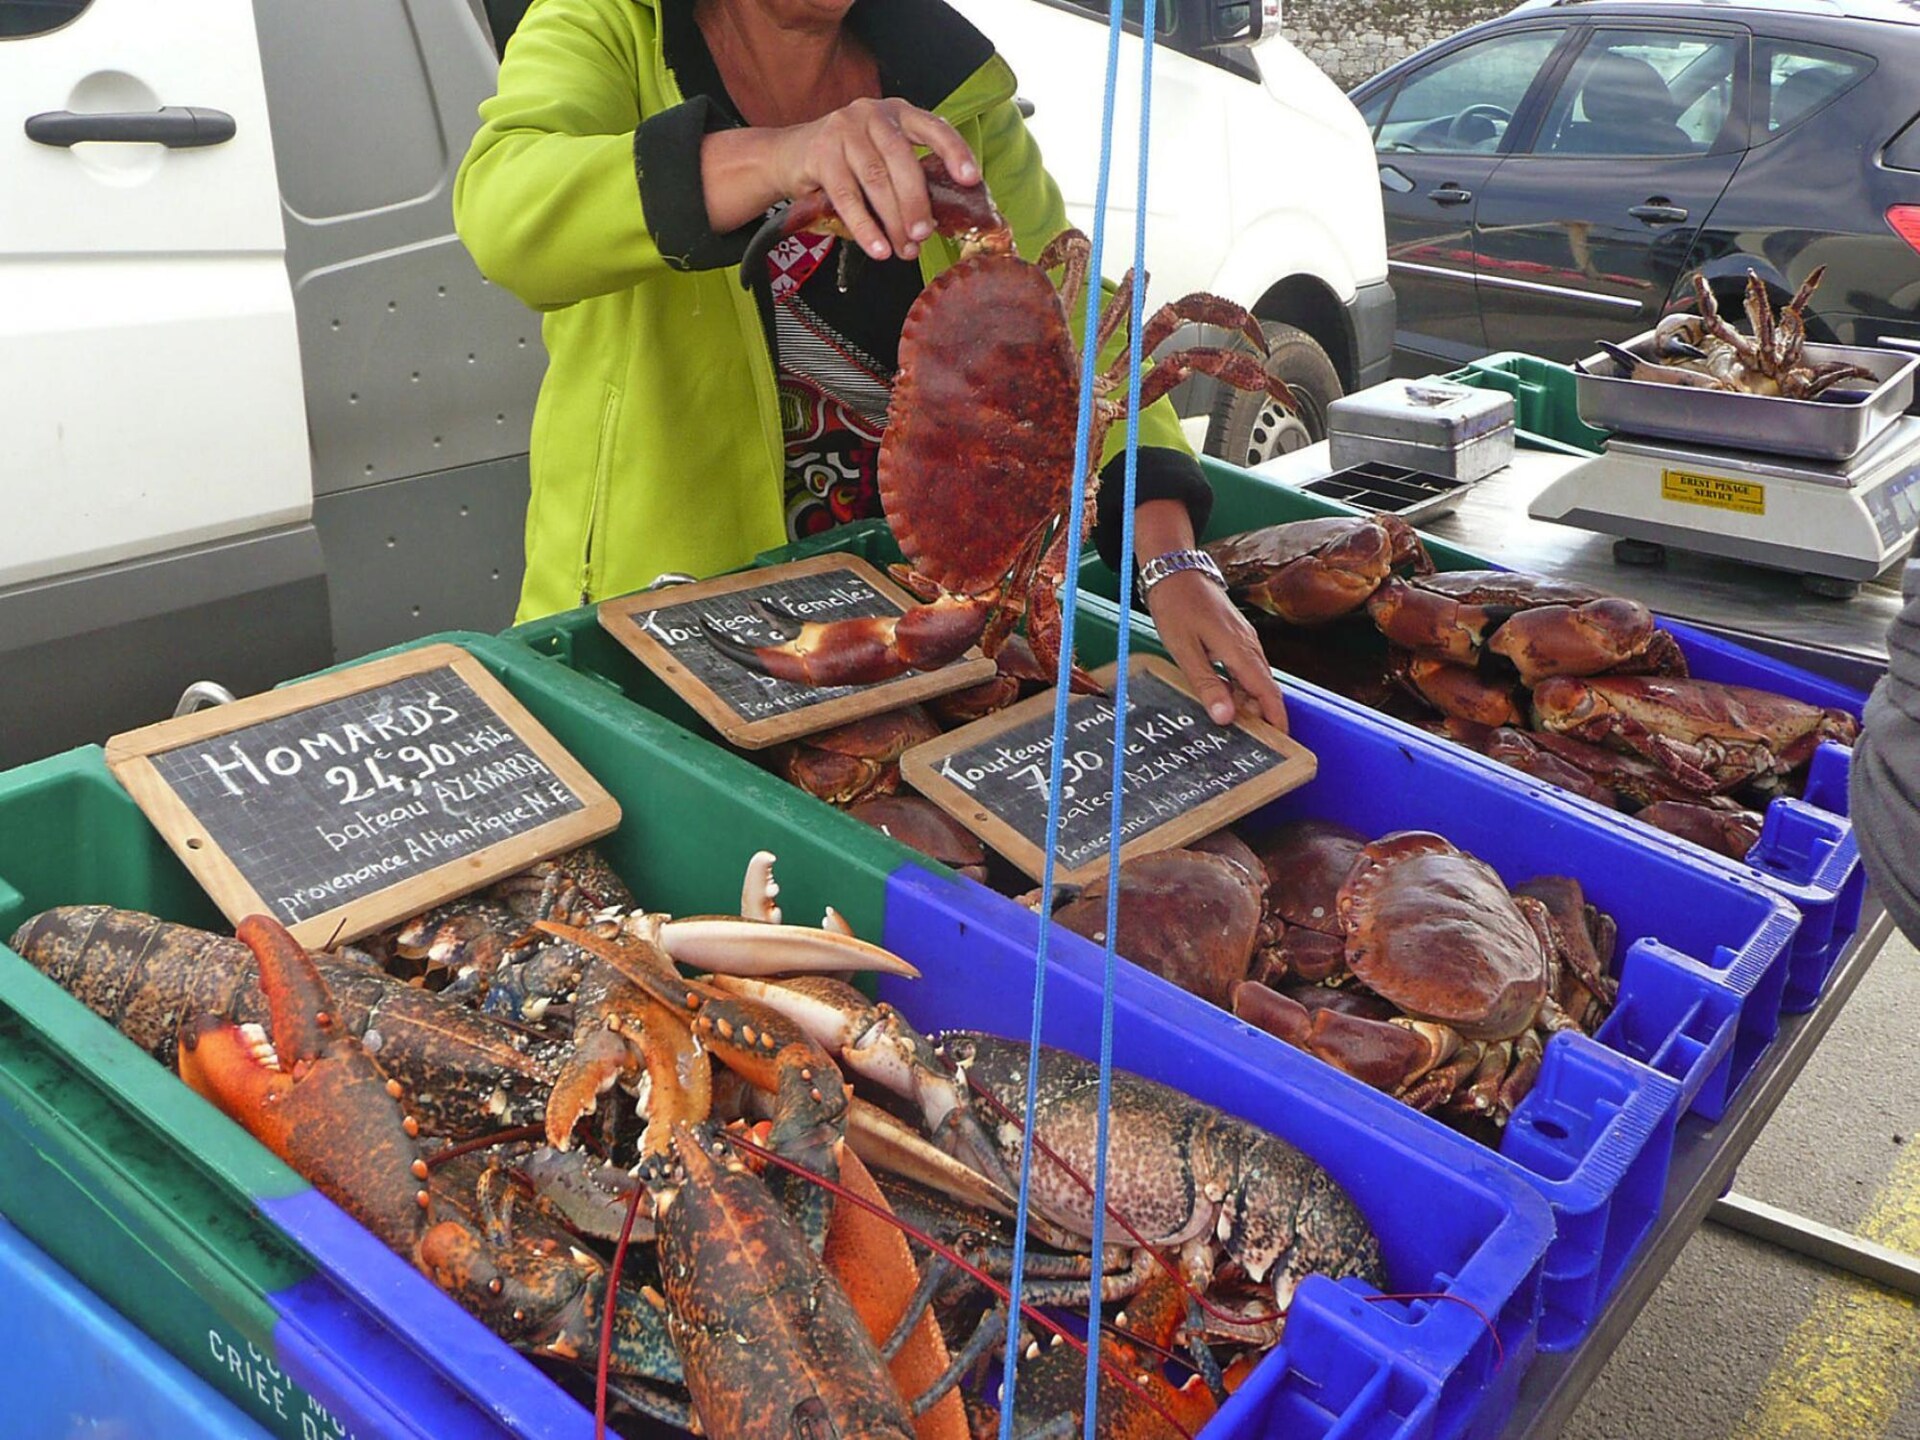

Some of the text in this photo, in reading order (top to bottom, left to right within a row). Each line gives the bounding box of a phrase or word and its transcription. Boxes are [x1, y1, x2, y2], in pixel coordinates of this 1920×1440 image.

[201, 692, 459, 796] HOMARDS
[1123, 733, 1228, 789] AZKARRA
[1135, 713, 1194, 744] Kilo
[316, 753, 549, 851] bateau AZKARRA
[278, 854, 409, 923] provenance
[404, 806, 538, 860] Atlantique
[209, 1329, 288, 1420] CRIEE
